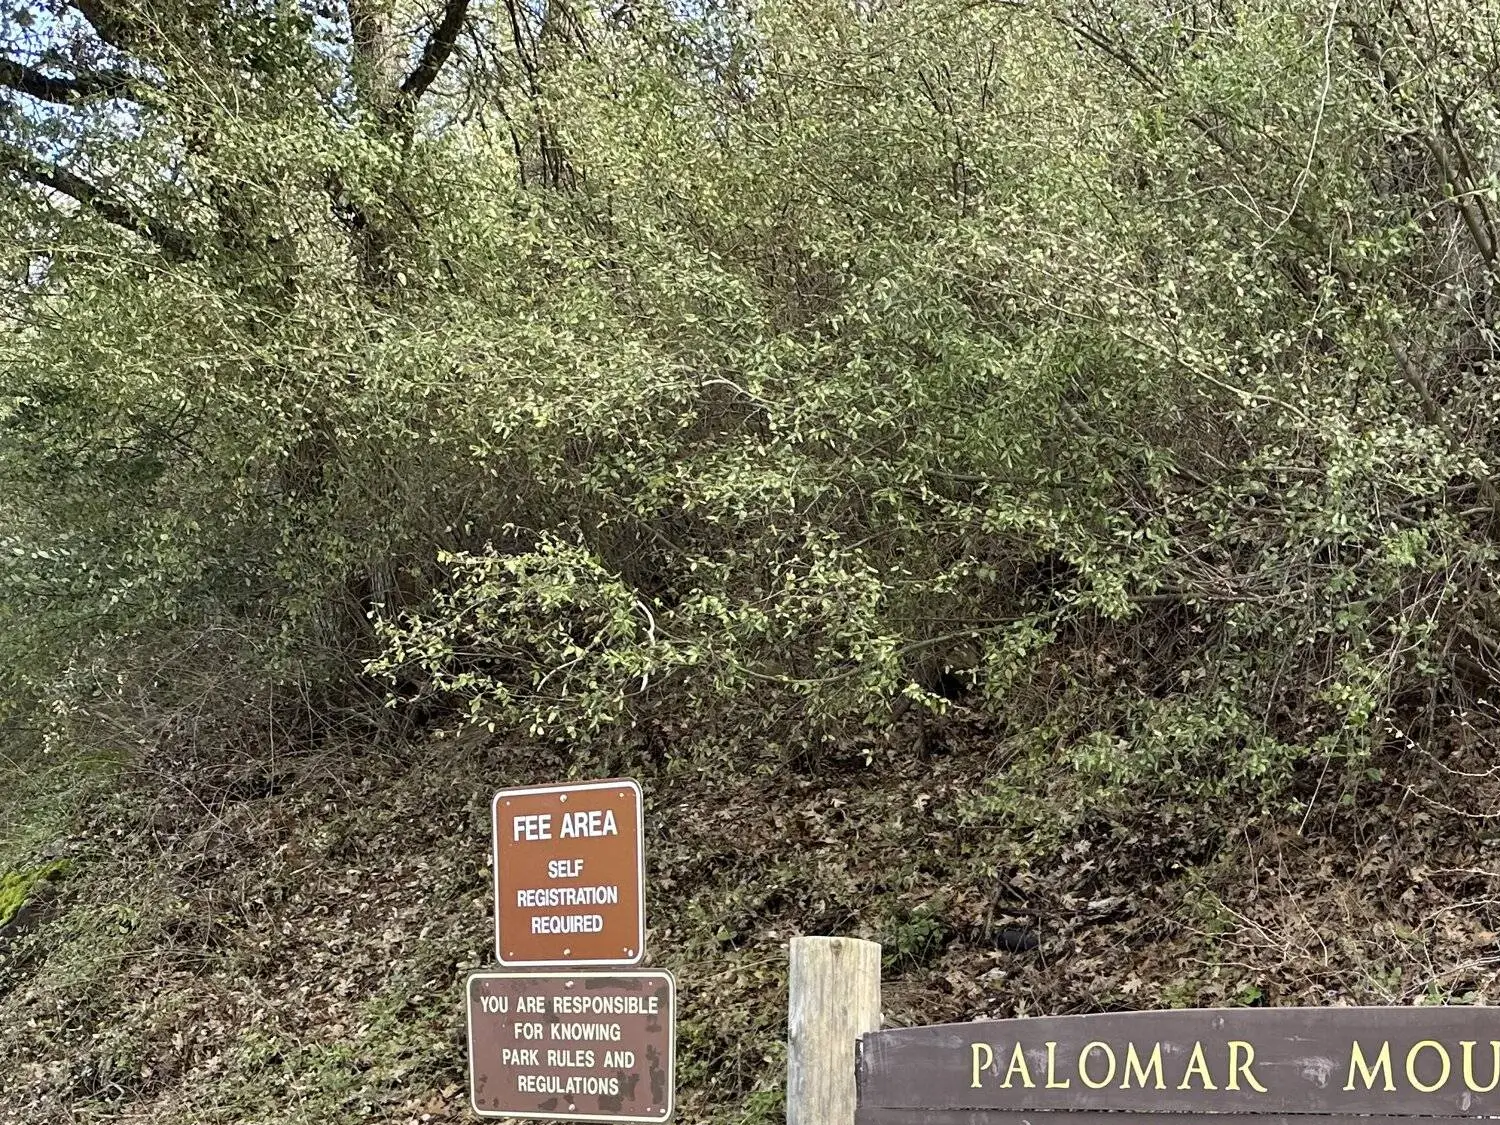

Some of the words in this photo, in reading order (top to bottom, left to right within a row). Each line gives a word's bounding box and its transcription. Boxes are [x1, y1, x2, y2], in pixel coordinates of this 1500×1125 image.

[513, 814, 552, 841] FEE
[560, 809, 618, 838] AREA
[548, 859, 584, 879] SELF
[517, 886, 618, 907] REGISTRATION
[531, 915, 603, 934] REQUIRED
[480, 996, 508, 1013] YOU
[516, 996, 545, 1014] ARE
[553, 996, 658, 1015] RESPONSIBLE
[514, 1023, 543, 1040] FOR
[551, 1023, 621, 1041] KNOWING
[503, 1049, 539, 1066] PARK
[548, 1050, 595, 1068] RULES
[603, 1050, 635, 1069] AND
[970, 1040, 1268, 1094] PALOMAR
[518, 1075, 619, 1095] REGULATIONS
